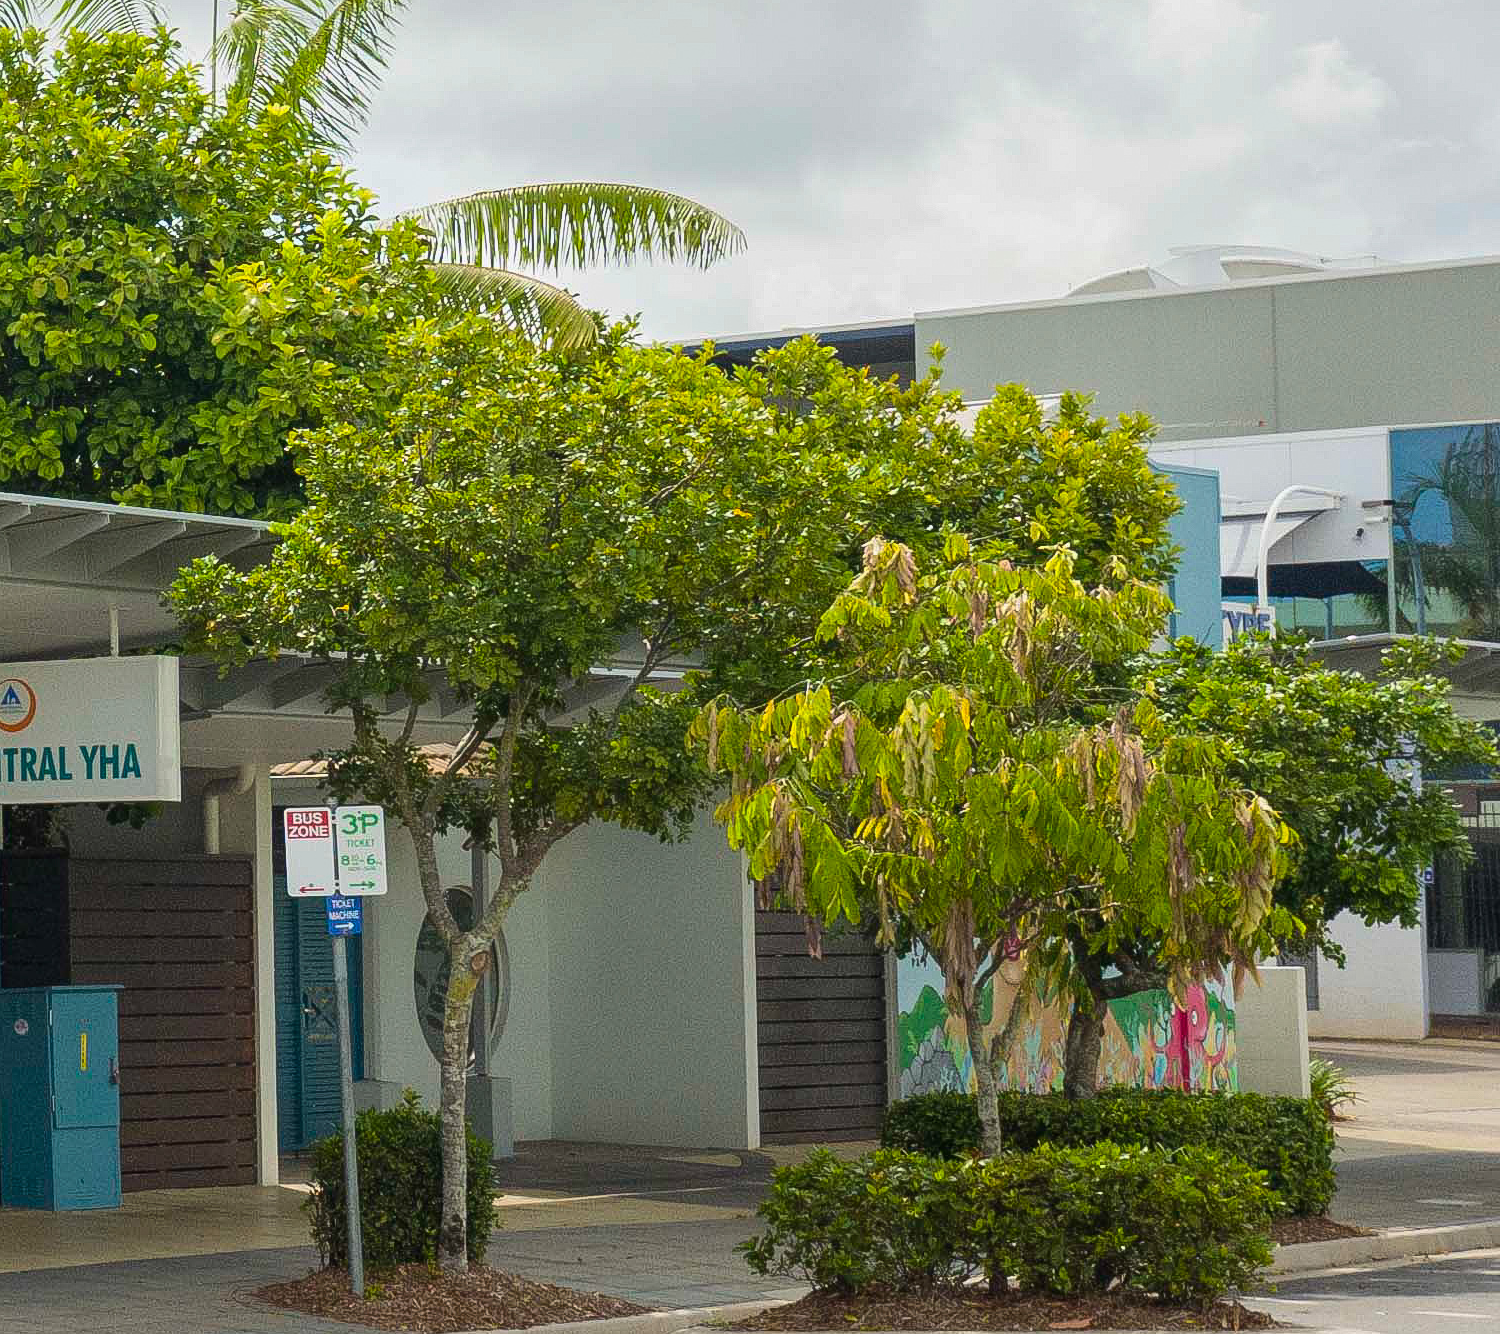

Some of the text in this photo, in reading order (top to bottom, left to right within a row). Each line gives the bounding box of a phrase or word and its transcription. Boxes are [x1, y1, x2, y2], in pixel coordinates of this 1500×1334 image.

[78, 743, 142, 780] YHA
[292, 812, 323, 824] BUS
[341, 813, 379, 835] 3P
[288, 825, 329, 838] ZONE
[331, 898, 355, 909] TICKET
